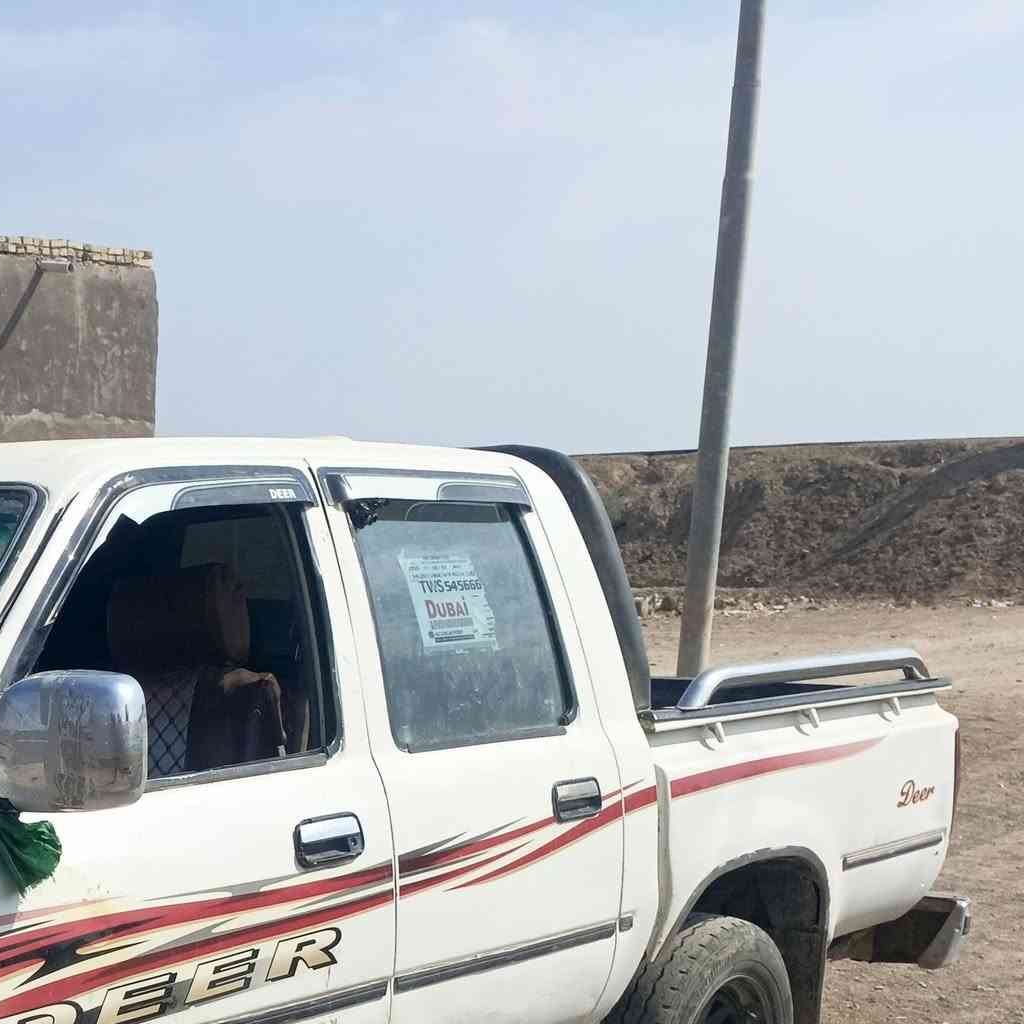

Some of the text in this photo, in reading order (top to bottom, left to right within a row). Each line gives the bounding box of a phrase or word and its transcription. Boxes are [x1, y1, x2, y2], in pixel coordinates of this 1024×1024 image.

[269, 489, 296, 499] DEER
[425, 599, 469, 619] DUBAI
[897, 780, 935, 808] Deer
